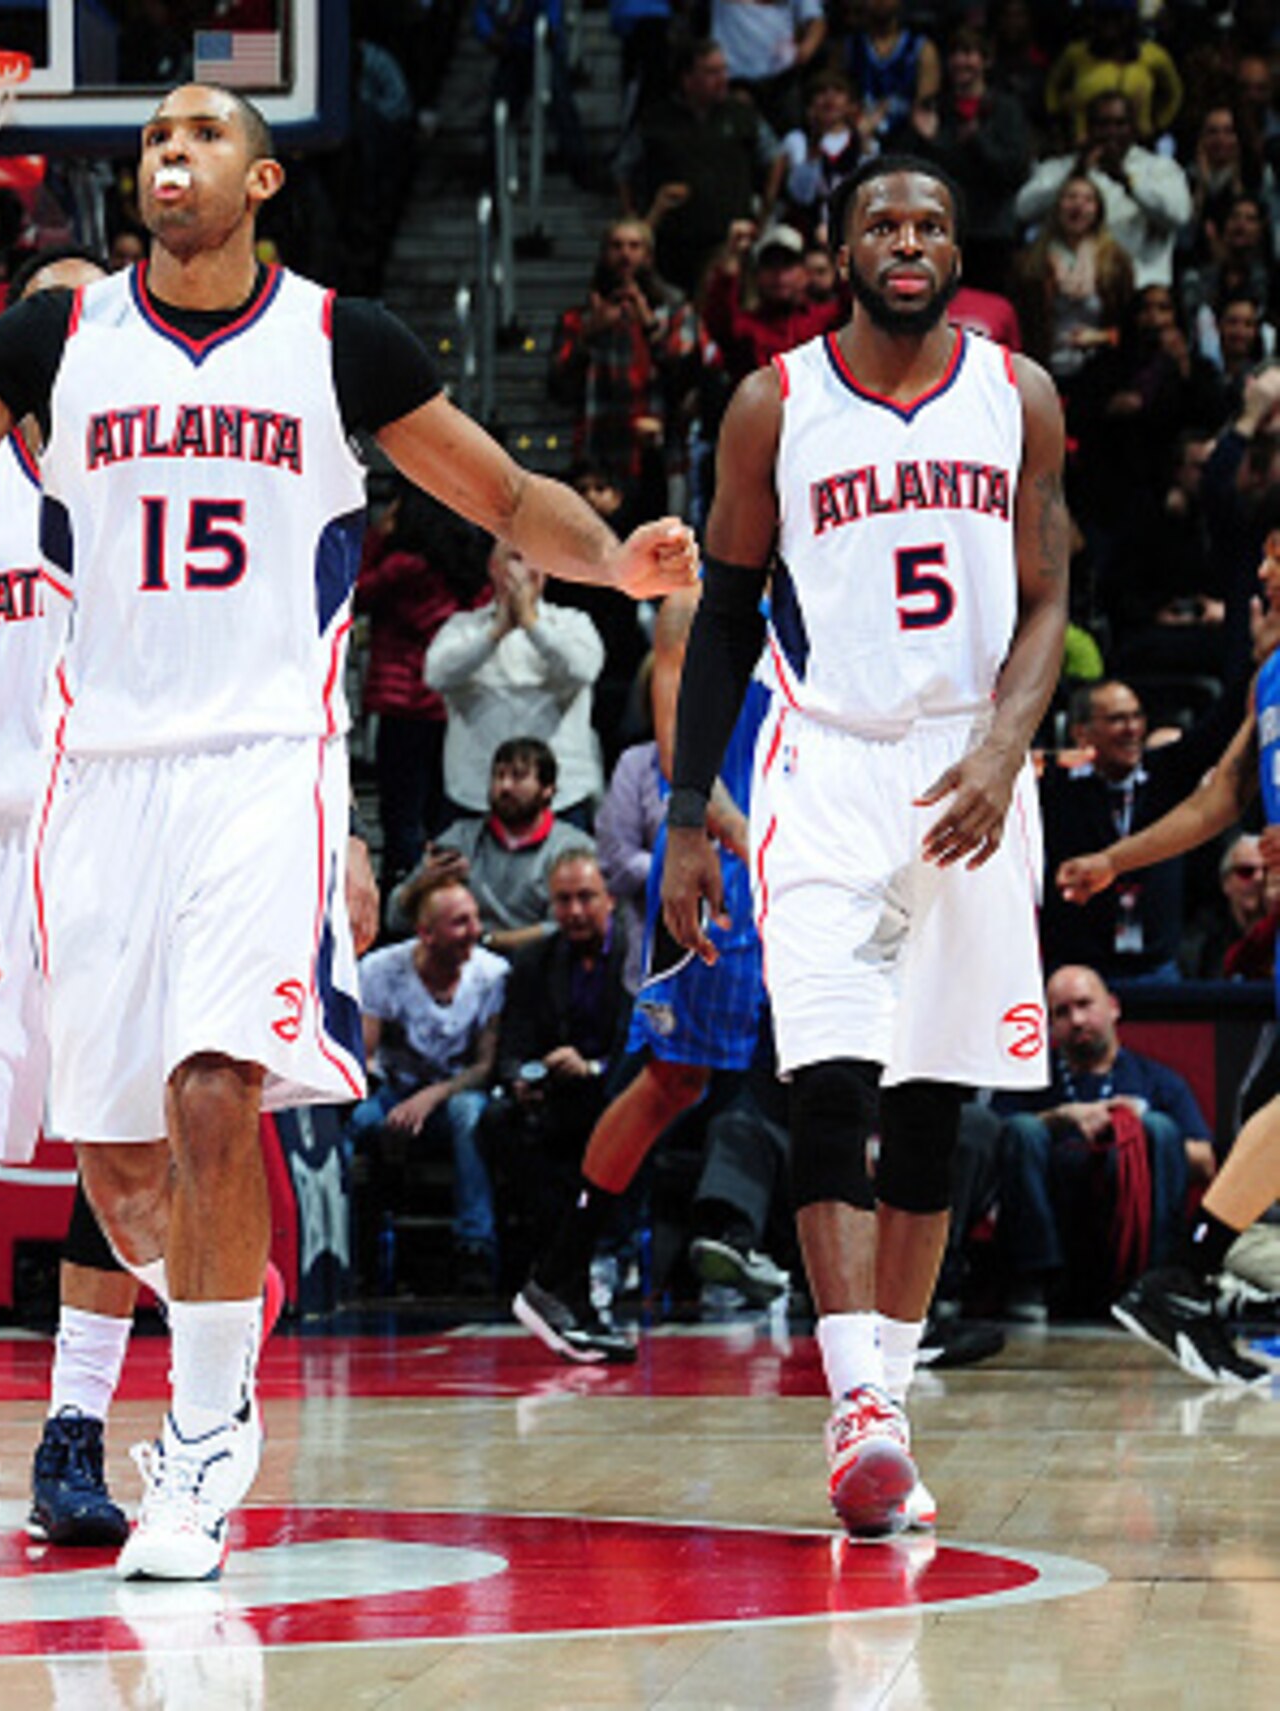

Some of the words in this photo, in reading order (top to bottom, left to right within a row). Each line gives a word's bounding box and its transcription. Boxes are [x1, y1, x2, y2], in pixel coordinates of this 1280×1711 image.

[86, 404, 302, 476] ATLANTA
[810, 460, 1009, 536] ATLANTA
[138, 495, 247, 591] 15
[893, 542, 956, 631] 5
